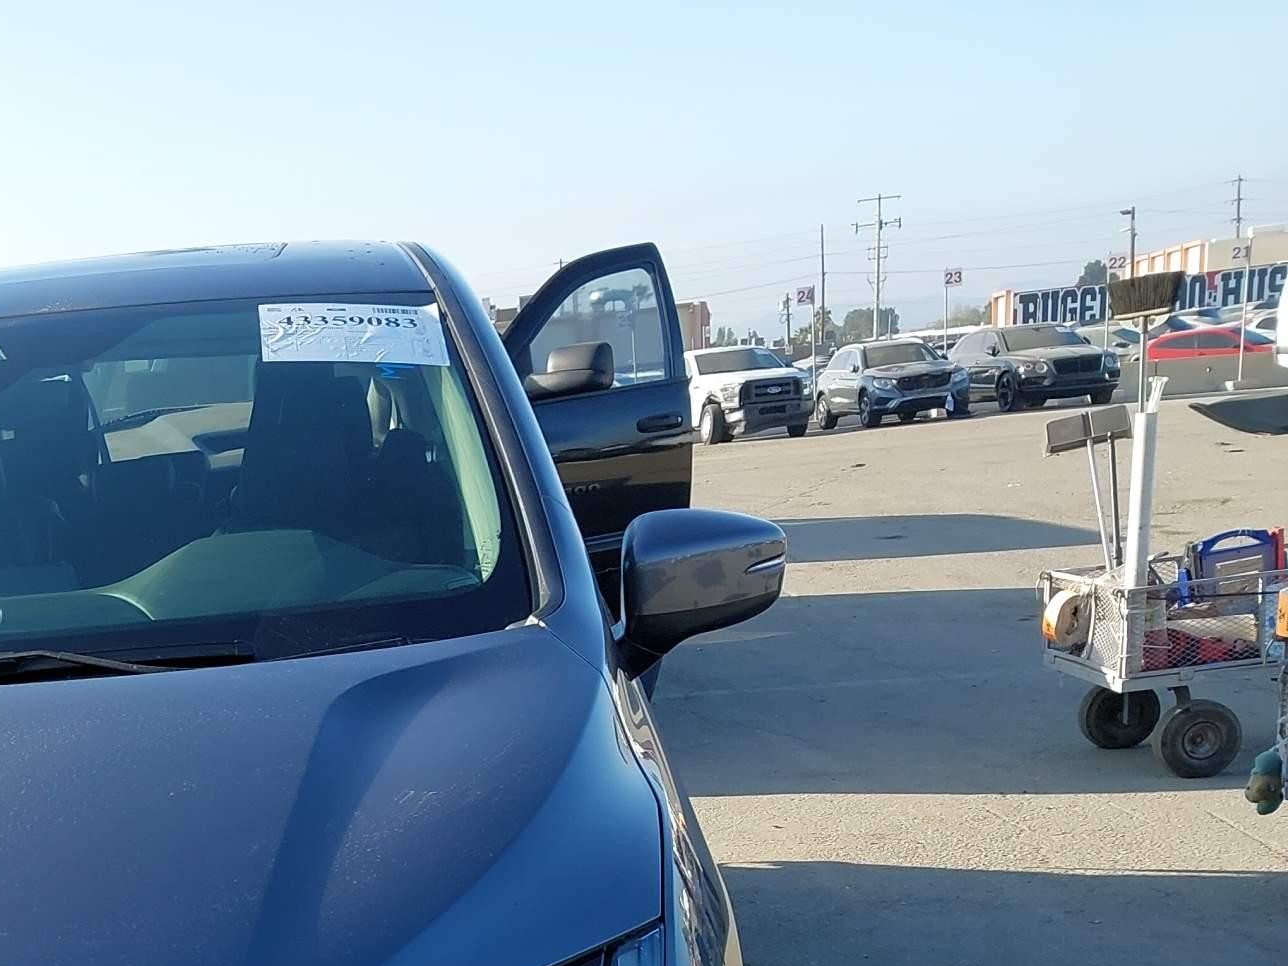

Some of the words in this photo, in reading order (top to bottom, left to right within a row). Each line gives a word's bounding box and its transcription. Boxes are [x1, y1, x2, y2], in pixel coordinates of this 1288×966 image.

[1232, 246, 1249, 259] 21
[1109, 256, 1126, 269] 22
[945, 271, 961, 285] 23
[797, 290, 812, 303] 24
[278, 315, 418, 329] 43359083
